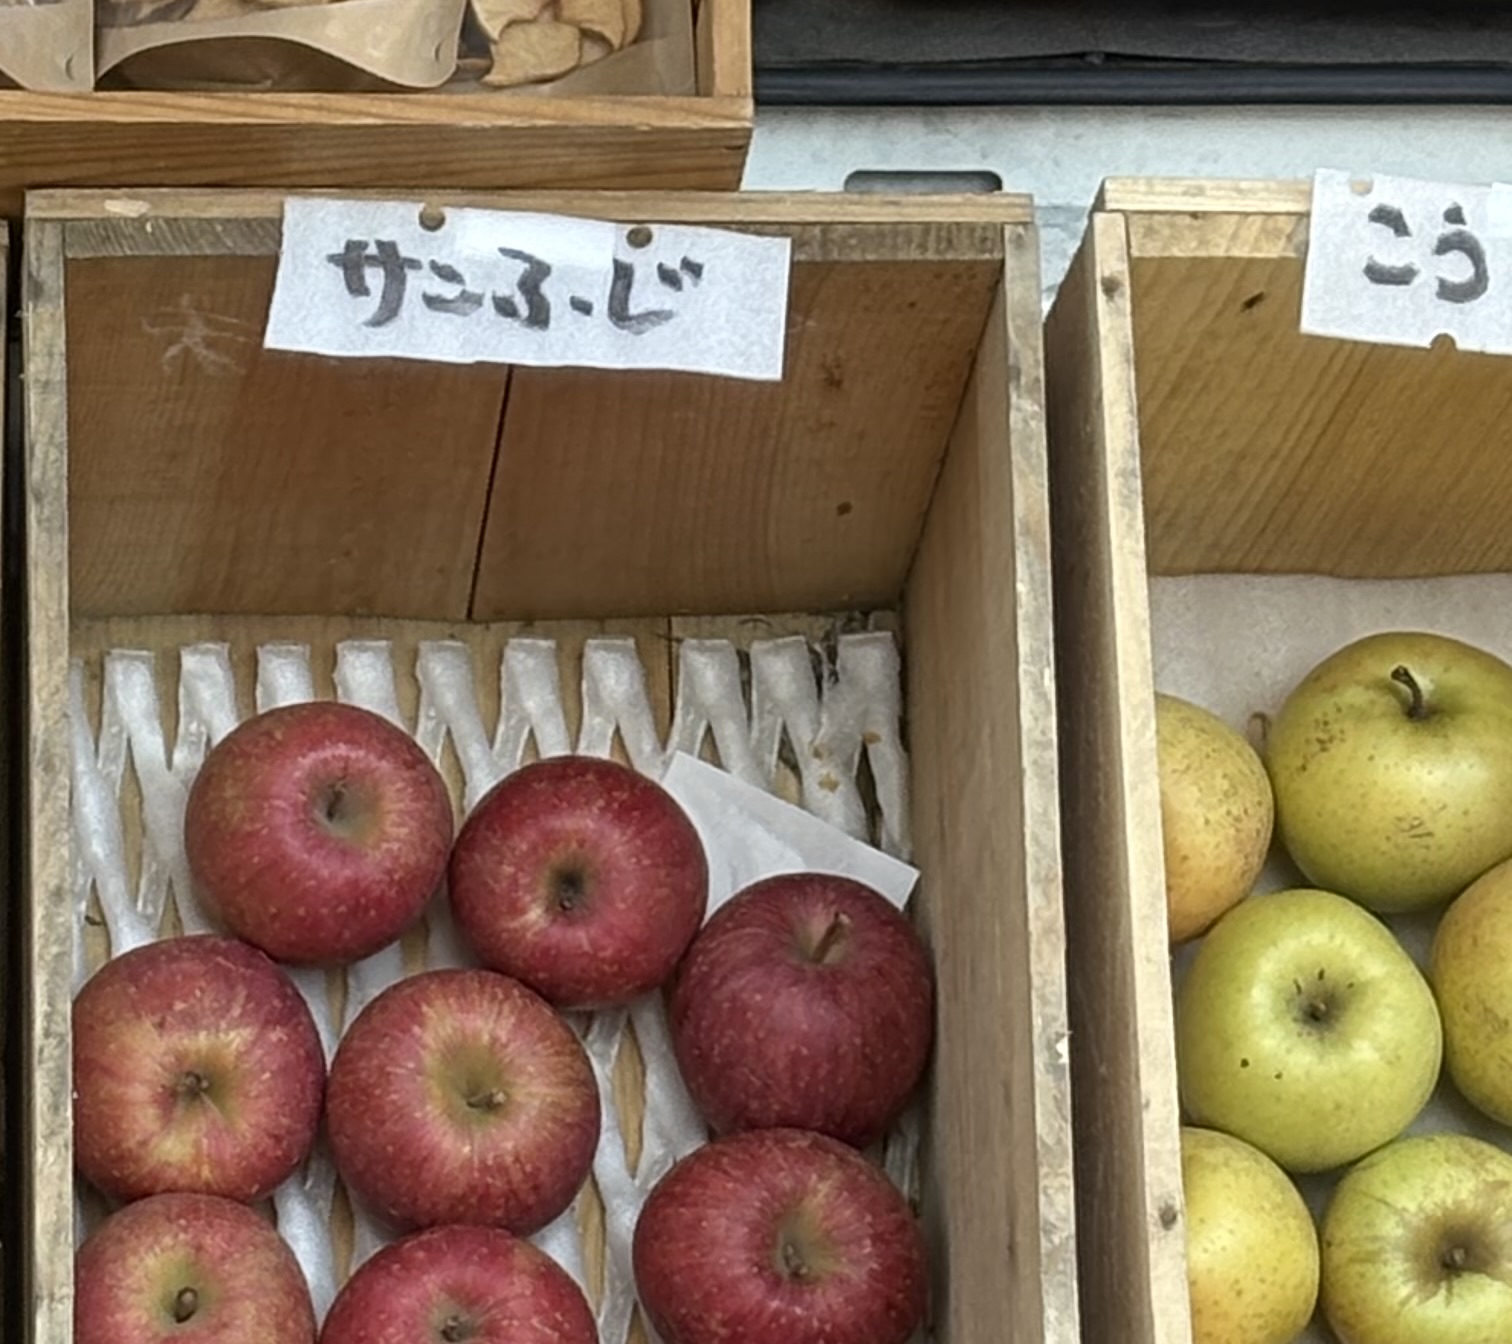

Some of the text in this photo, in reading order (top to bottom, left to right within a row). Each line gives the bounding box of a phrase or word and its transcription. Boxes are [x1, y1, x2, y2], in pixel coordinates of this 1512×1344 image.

[327, 239, 704, 334] サンふじ
[1363, 201, 1490, 303] こう
